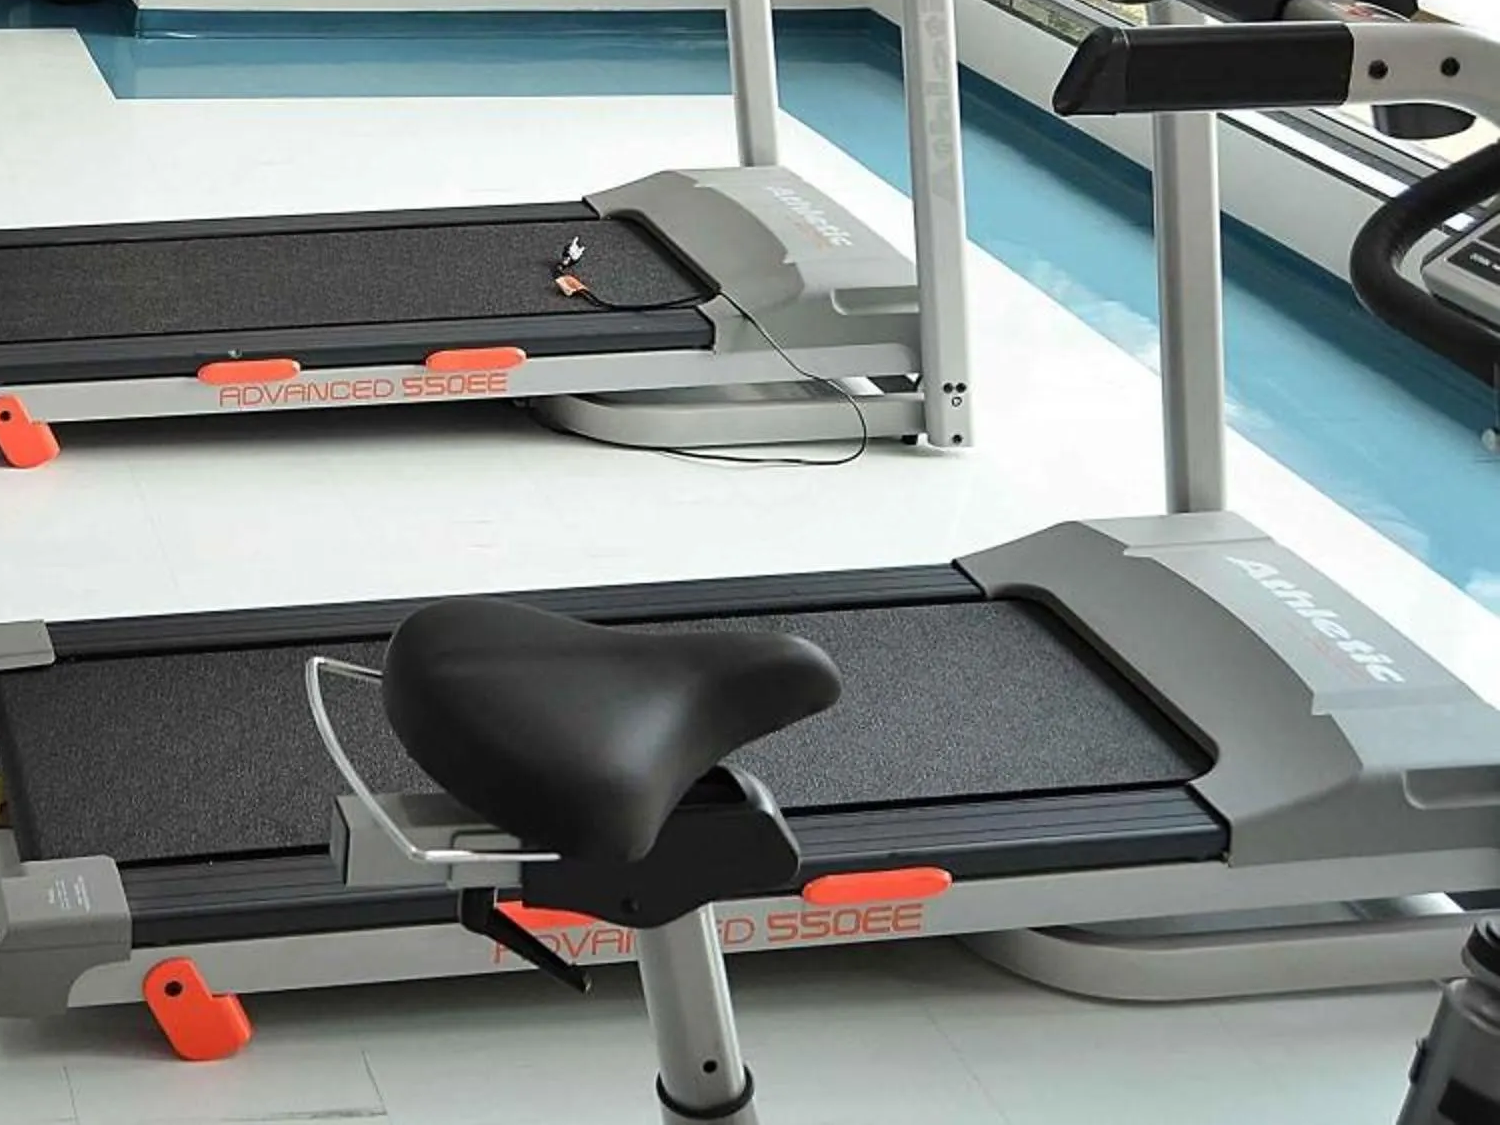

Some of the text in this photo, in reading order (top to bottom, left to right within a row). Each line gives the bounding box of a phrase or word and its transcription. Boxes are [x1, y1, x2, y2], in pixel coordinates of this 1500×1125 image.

[765, 185, 855, 246] Athletic
[219, 378, 394, 408] ADVANCED
[1224, 555, 1407, 683] Athletic
